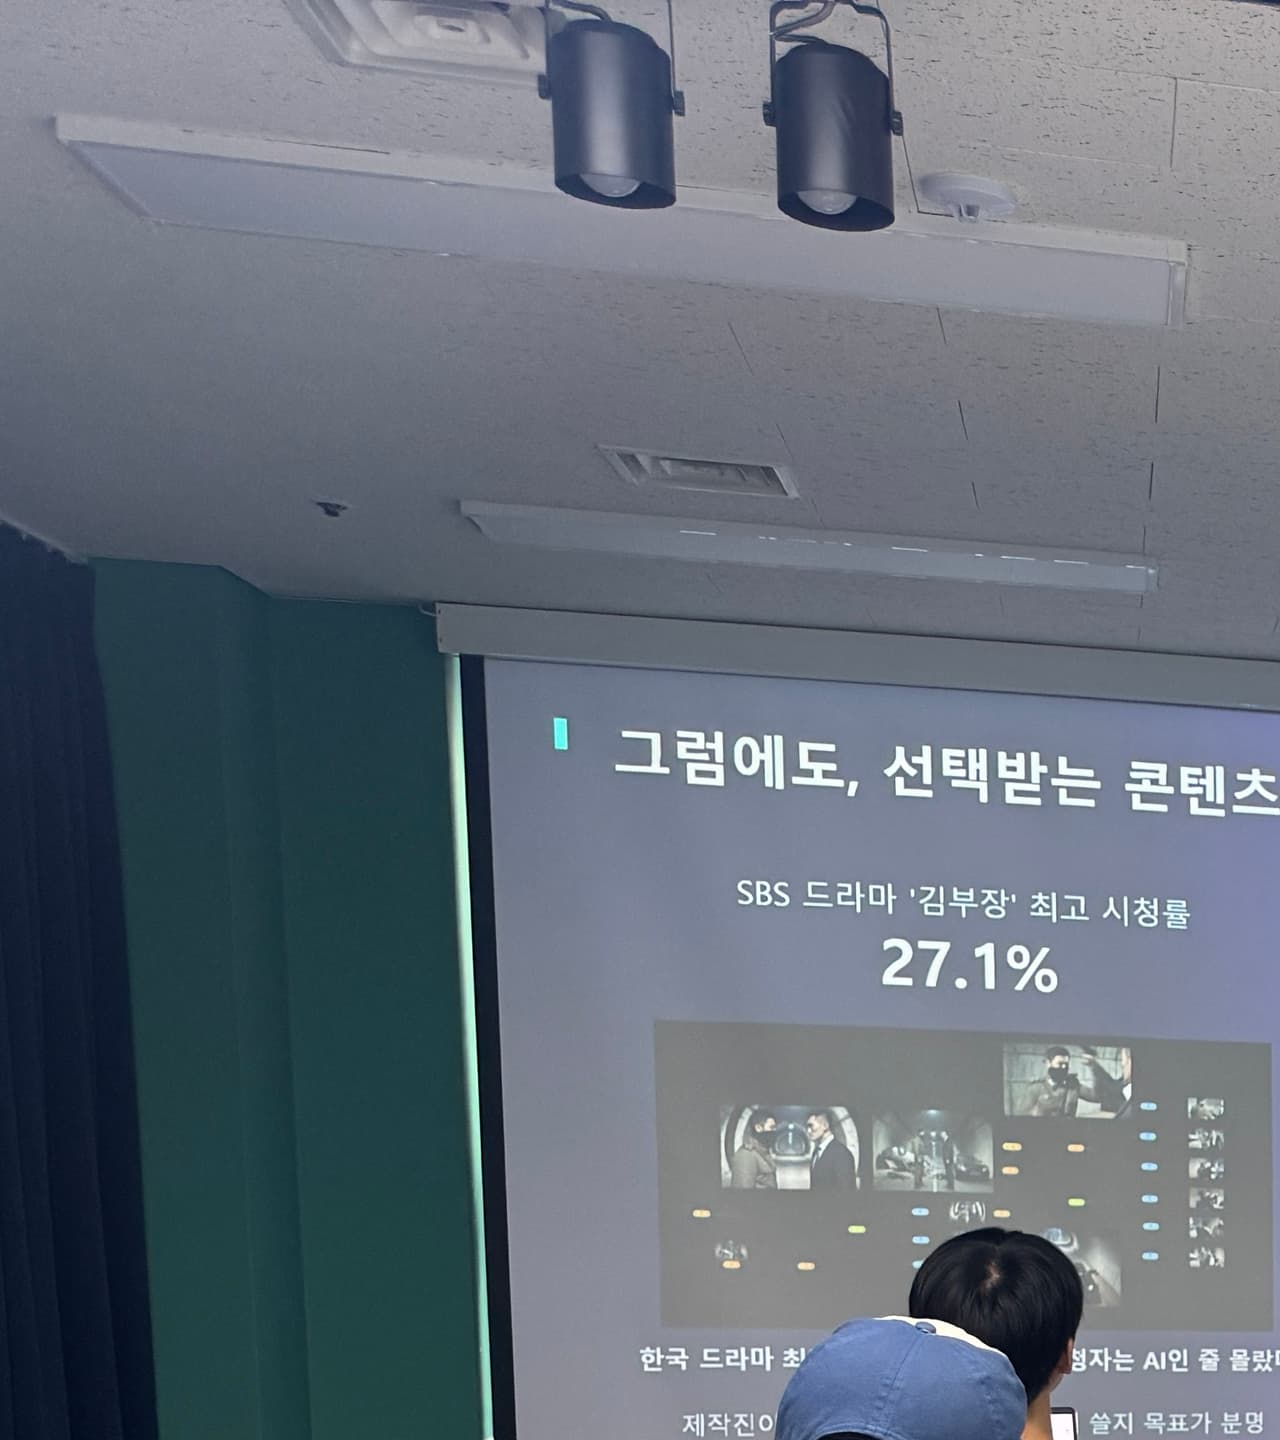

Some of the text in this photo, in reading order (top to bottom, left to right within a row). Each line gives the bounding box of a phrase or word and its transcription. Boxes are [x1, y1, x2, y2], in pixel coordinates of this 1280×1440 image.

[615, 730, 859, 797] 그럼에도,
[883, 744, 1101, 808] 선택받는
[736, 880, 1191, 930] SBS 드라마 '김부장' 최고 시청률
[882, 937, 1058, 994] 27.1%
[639, 1346, 690, 1372] 한국
[700, 1346, 775, 1372] 드라마
[1143, 1348, 1189, 1372] AI인
[1198, 1348, 1221, 1372] 줄
[1089, 1411, 1264, 1435] 쓸지 목표가 분명
